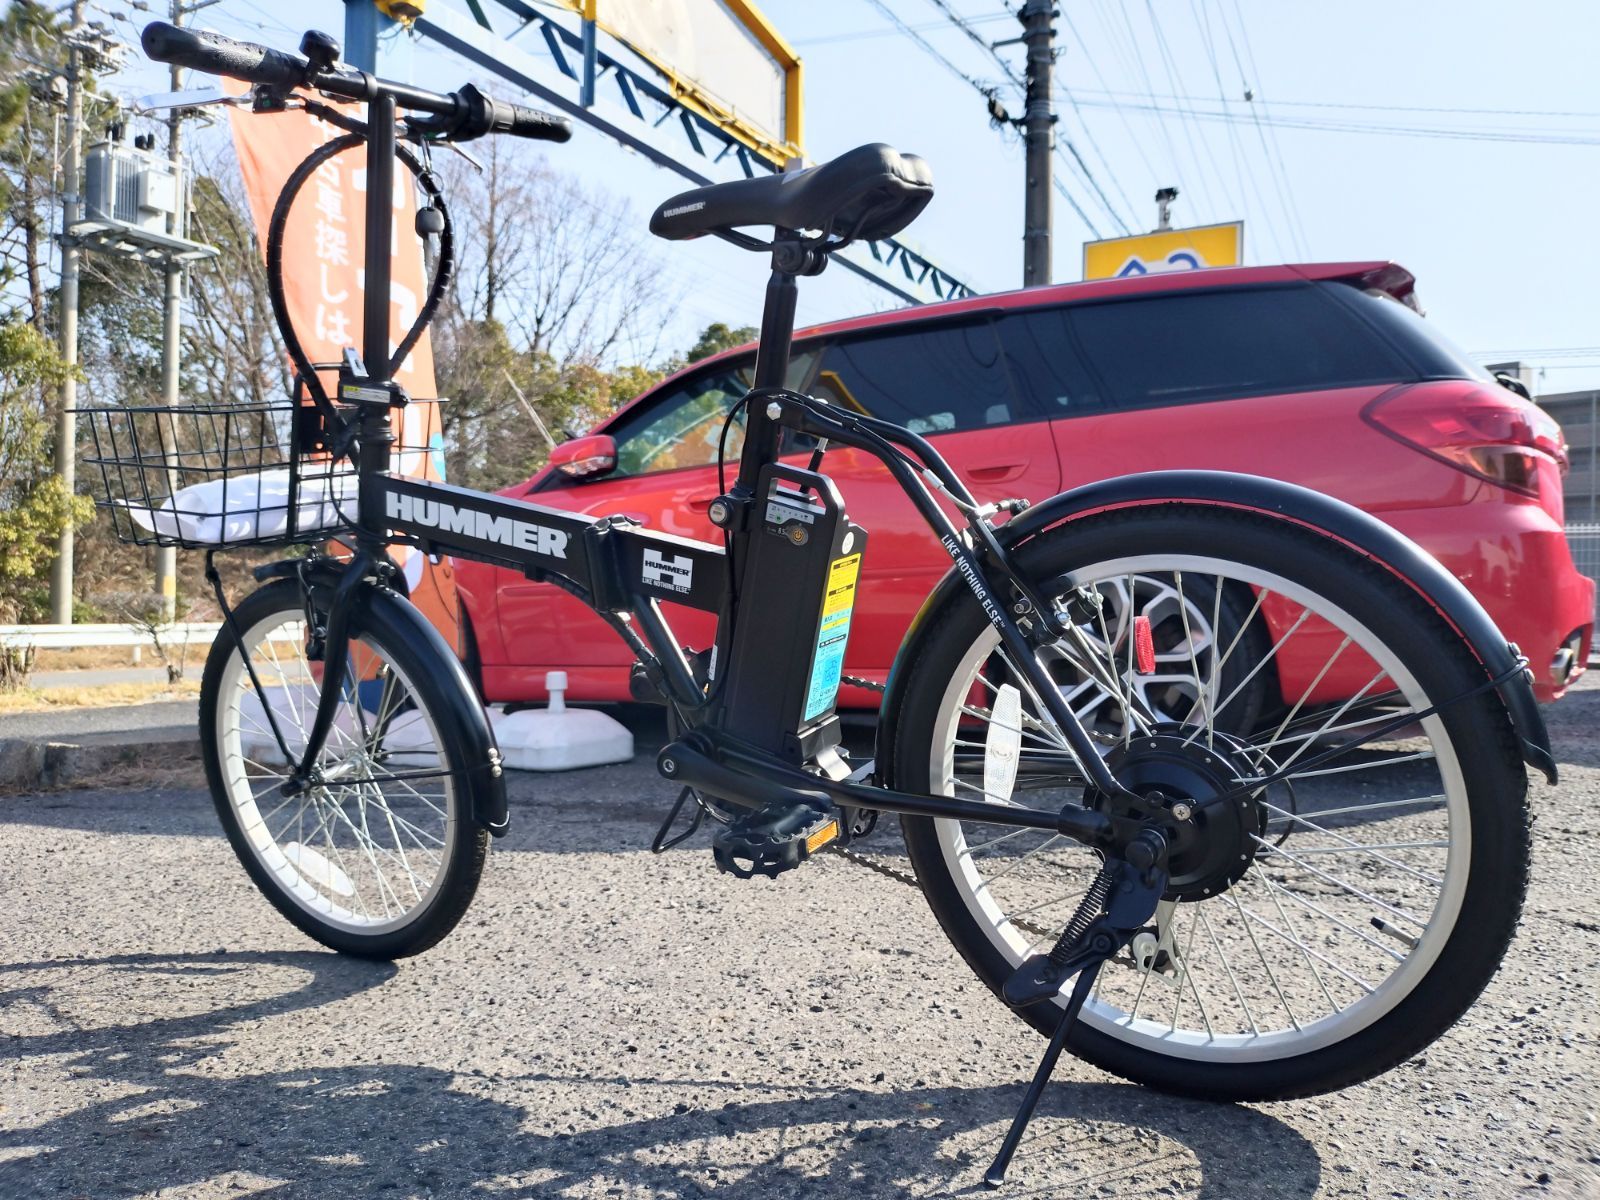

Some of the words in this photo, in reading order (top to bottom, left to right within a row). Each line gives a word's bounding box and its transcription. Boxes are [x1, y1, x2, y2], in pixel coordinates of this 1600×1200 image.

[663, 202, 704, 218] HUMMER
[386, 491, 568, 559] HUMMER
[645, 560, 689, 576] HUMMER
[941, 534, 961, 558] LIKE
[956, 556, 987, 600] NOTHING
[654, 580, 675, 590] NOTHING
